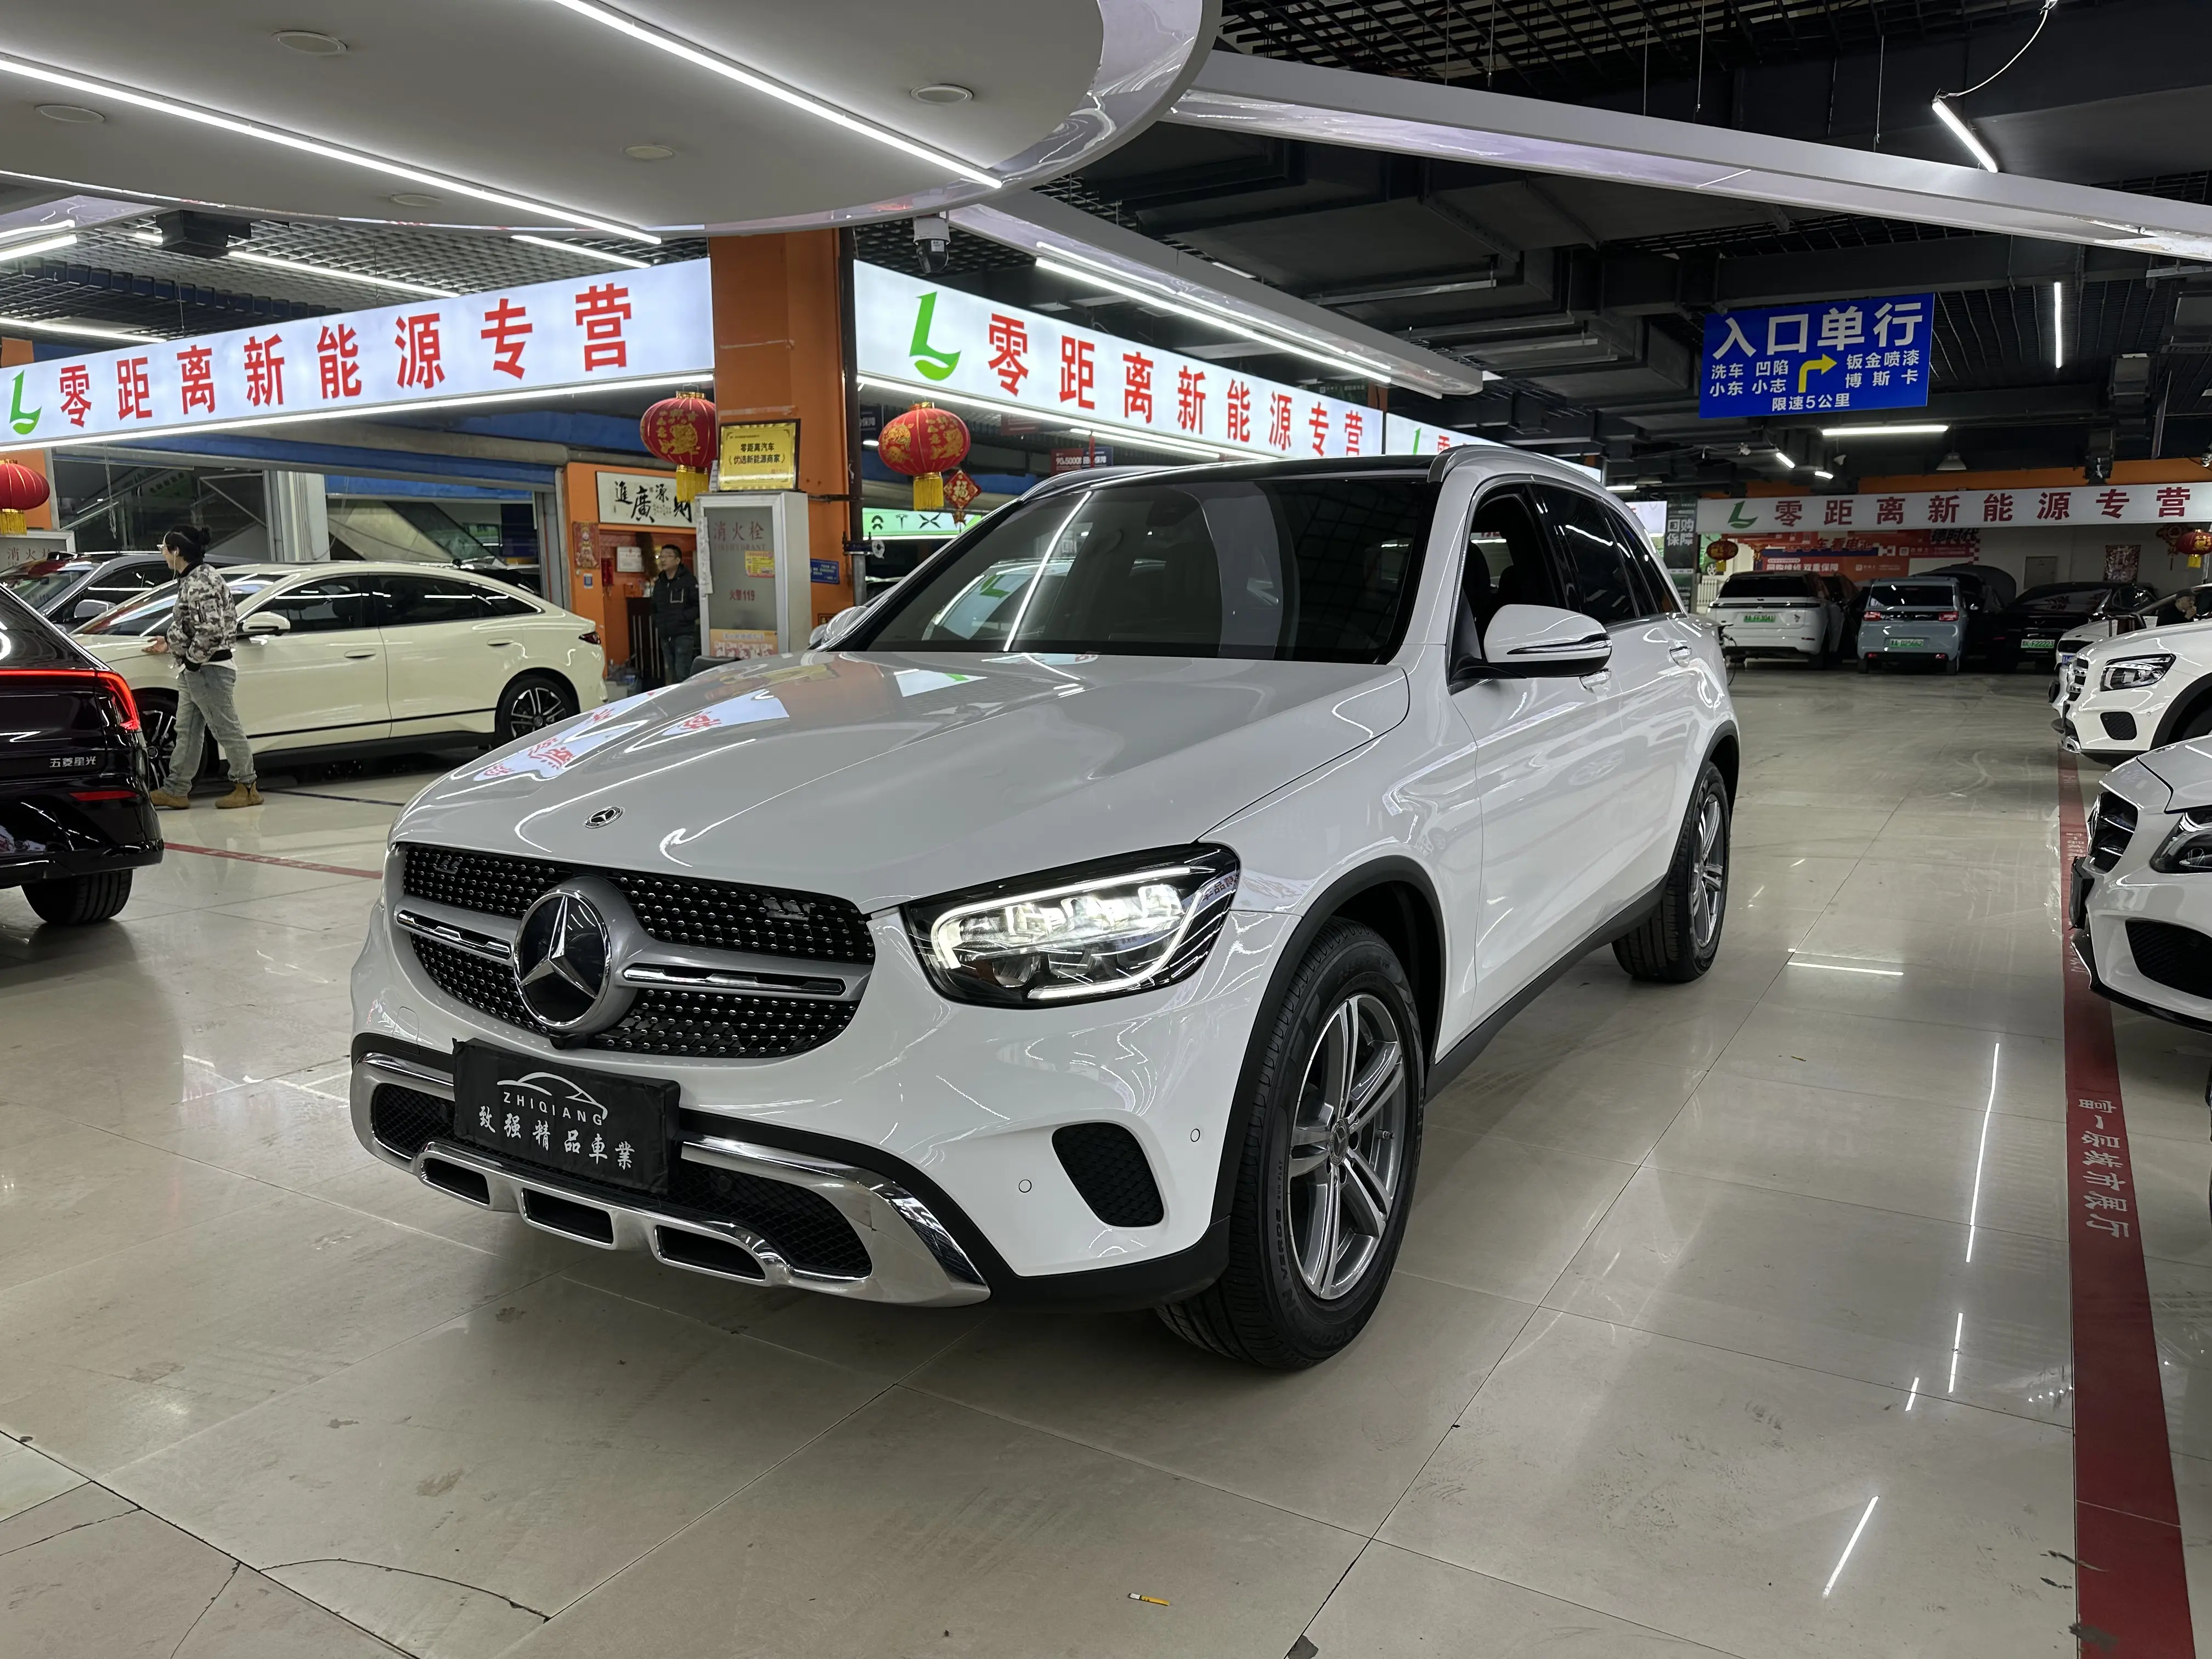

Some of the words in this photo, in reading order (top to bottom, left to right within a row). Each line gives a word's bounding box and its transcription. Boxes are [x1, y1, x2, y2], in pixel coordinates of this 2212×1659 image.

[1712, 302, 1923, 360] 入口单行
[59, 283, 634, 428] 零距离新能源专营
[1847, 349, 1920, 370] 钣金喷漆
[1711, 363, 1744, 380] 洗车
[1756, 359, 1789, 376] 凹陷
[1845, 369, 1918, 388] 博斯卡
[988, 313, 1363, 456] 零距离新能源专营
[1709, 380, 1743, 397] 小东
[1752, 377, 1786, 394] 小志
[1772, 393, 1850, 411] 限速5公里
[741, 442, 775, 453] 零距离汽车
[1774, 487, 2191, 527] 零距离新能源专营
[714, 521, 764, 541] 消火栓
[1667, 519, 1694, 533] 回购
[1666, 534, 1694, 546] 保障
[49, 756, 96, 769] 五菱星光
[503, 1091, 603, 1126] ZHIQIANG
[479, 1105, 635, 1170] 致强精品車業
[2078, 1098, 2130, 1239] 富一层城市展厅
[1276, 1208, 1289, 1280] VERDE
